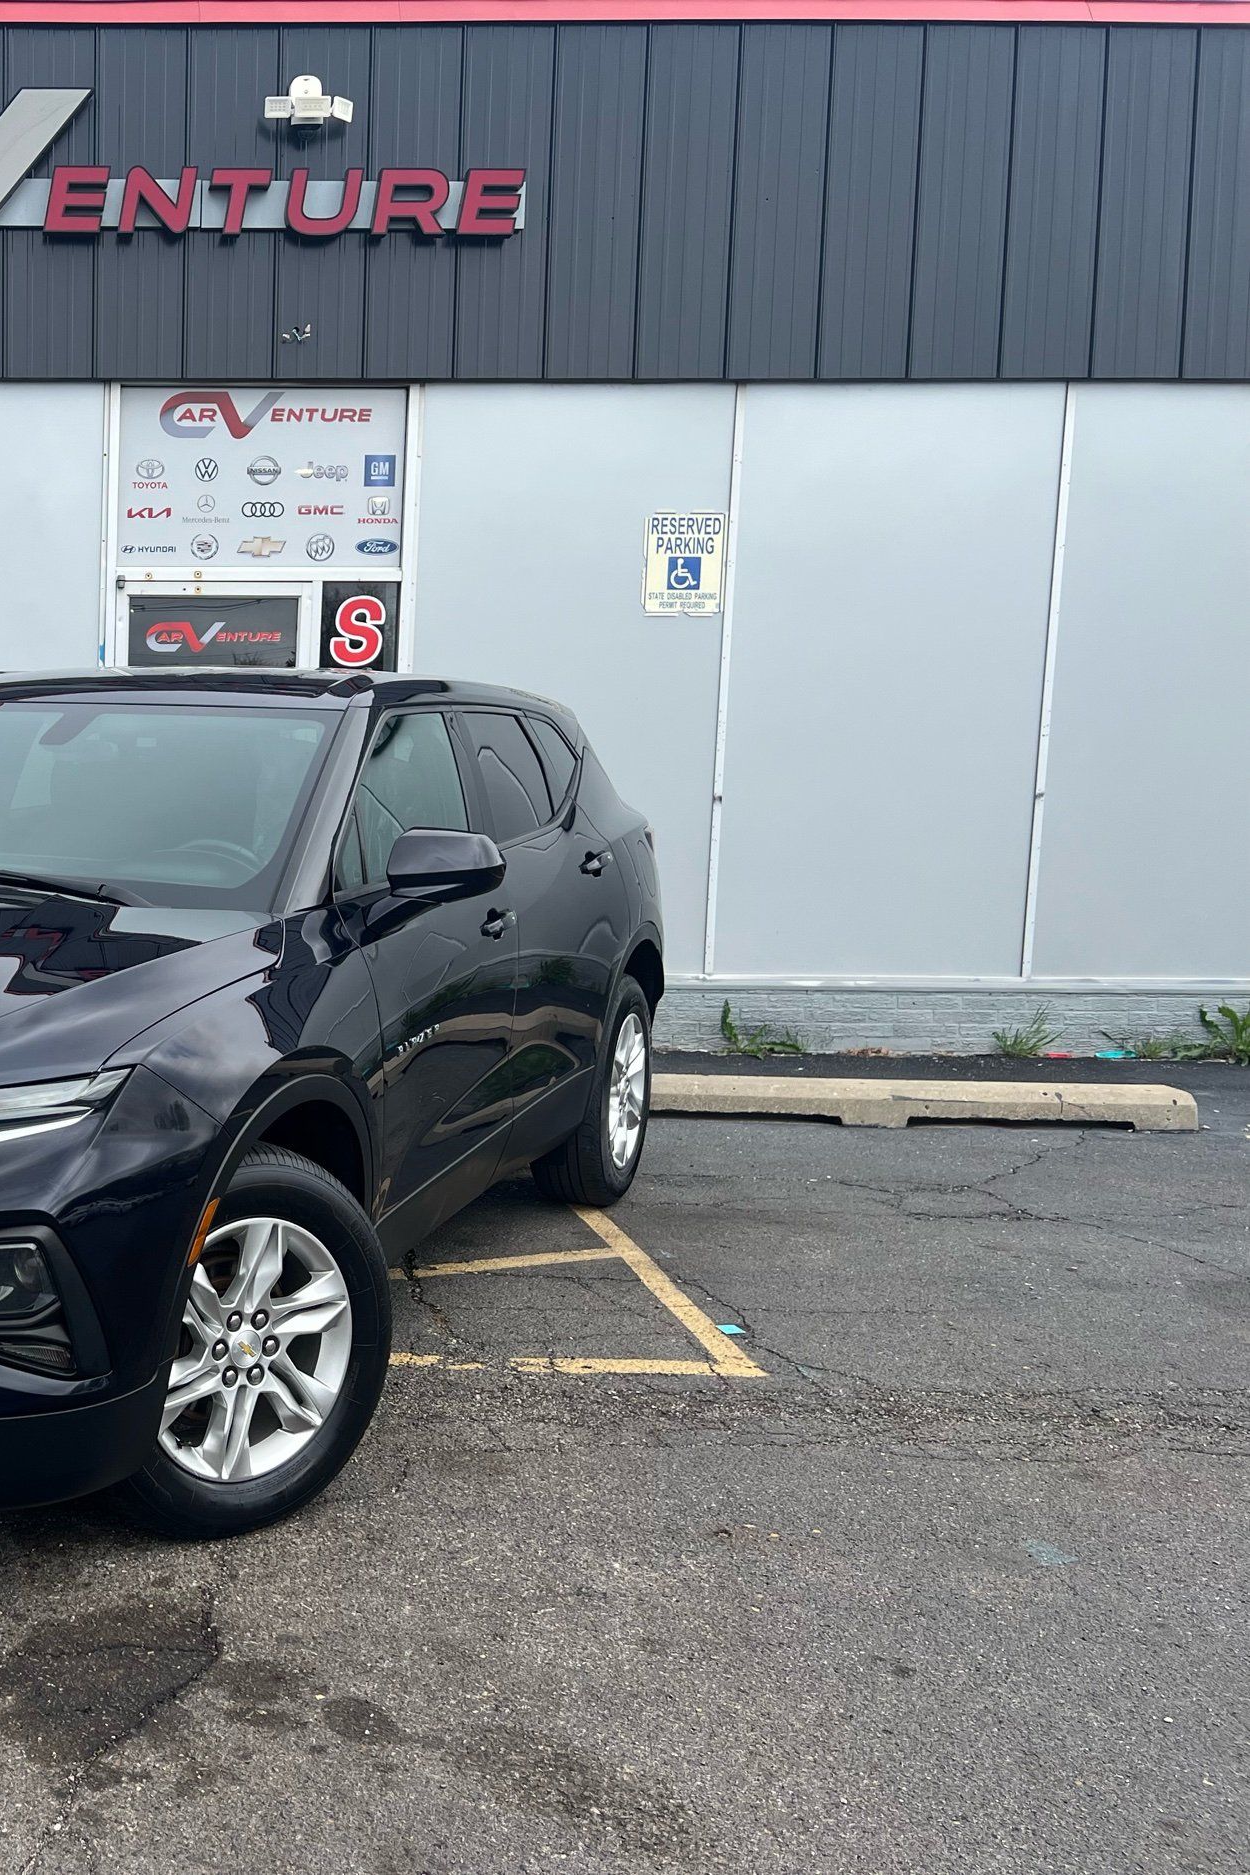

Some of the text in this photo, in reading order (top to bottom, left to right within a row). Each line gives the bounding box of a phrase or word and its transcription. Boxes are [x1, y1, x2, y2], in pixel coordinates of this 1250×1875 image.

[248, 467, 279, 475] NISSAN
[296, 461, 348, 481] Jeep
[371, 462, 389, 476] GM
[297, 505, 344, 515] GMC
[182, 516, 230, 524] Mercedes-Benz
[651, 517, 722, 535] RESERVED
[363, 541, 391, 553] Ford
[656, 537, 715, 554] PARKING
[648, 592, 717, 600] STATE DISABLED PARKING
[658, 601, 706, 609] PERMIT REQUIRED
[330, 595, 387, 667] S
